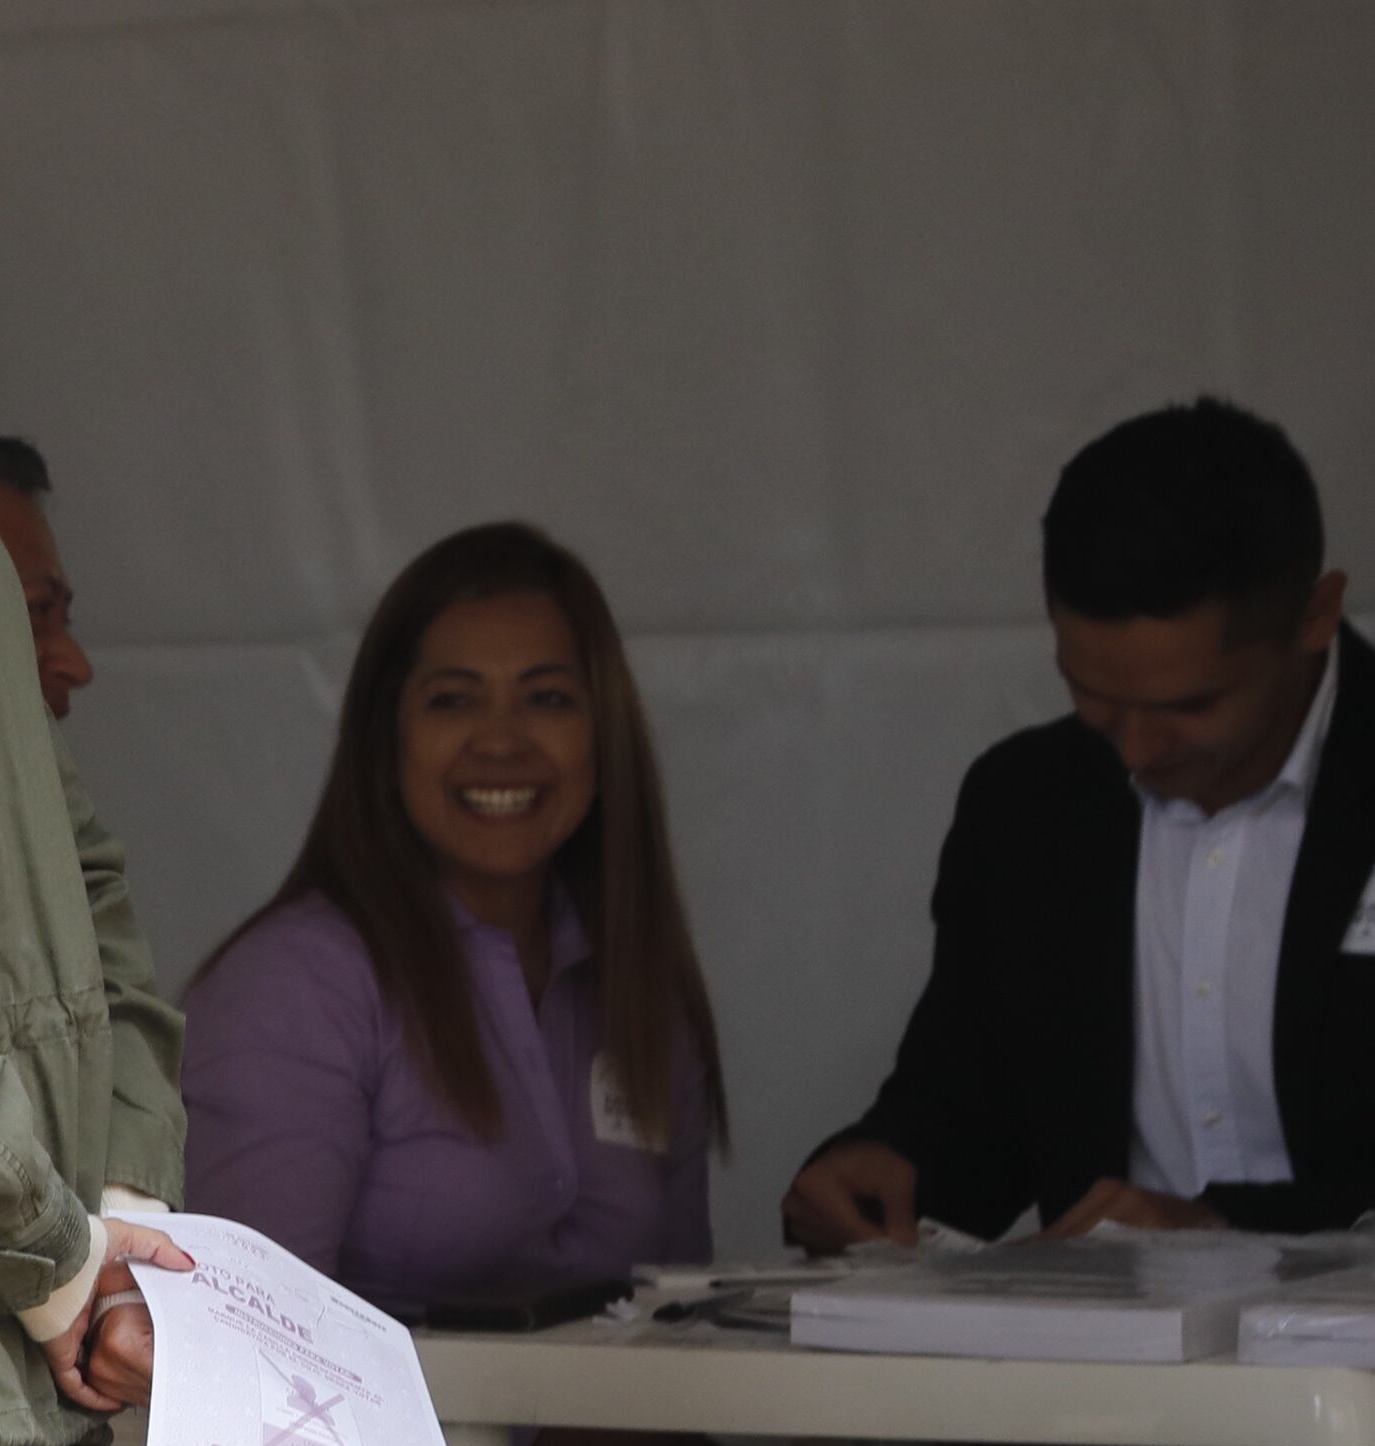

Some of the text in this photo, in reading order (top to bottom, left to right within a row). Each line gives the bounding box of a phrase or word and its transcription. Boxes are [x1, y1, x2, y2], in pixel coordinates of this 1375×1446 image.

[191, 1272, 314, 1344] ALCALDE
[196, 1261, 276, 1305] OTO PARA
